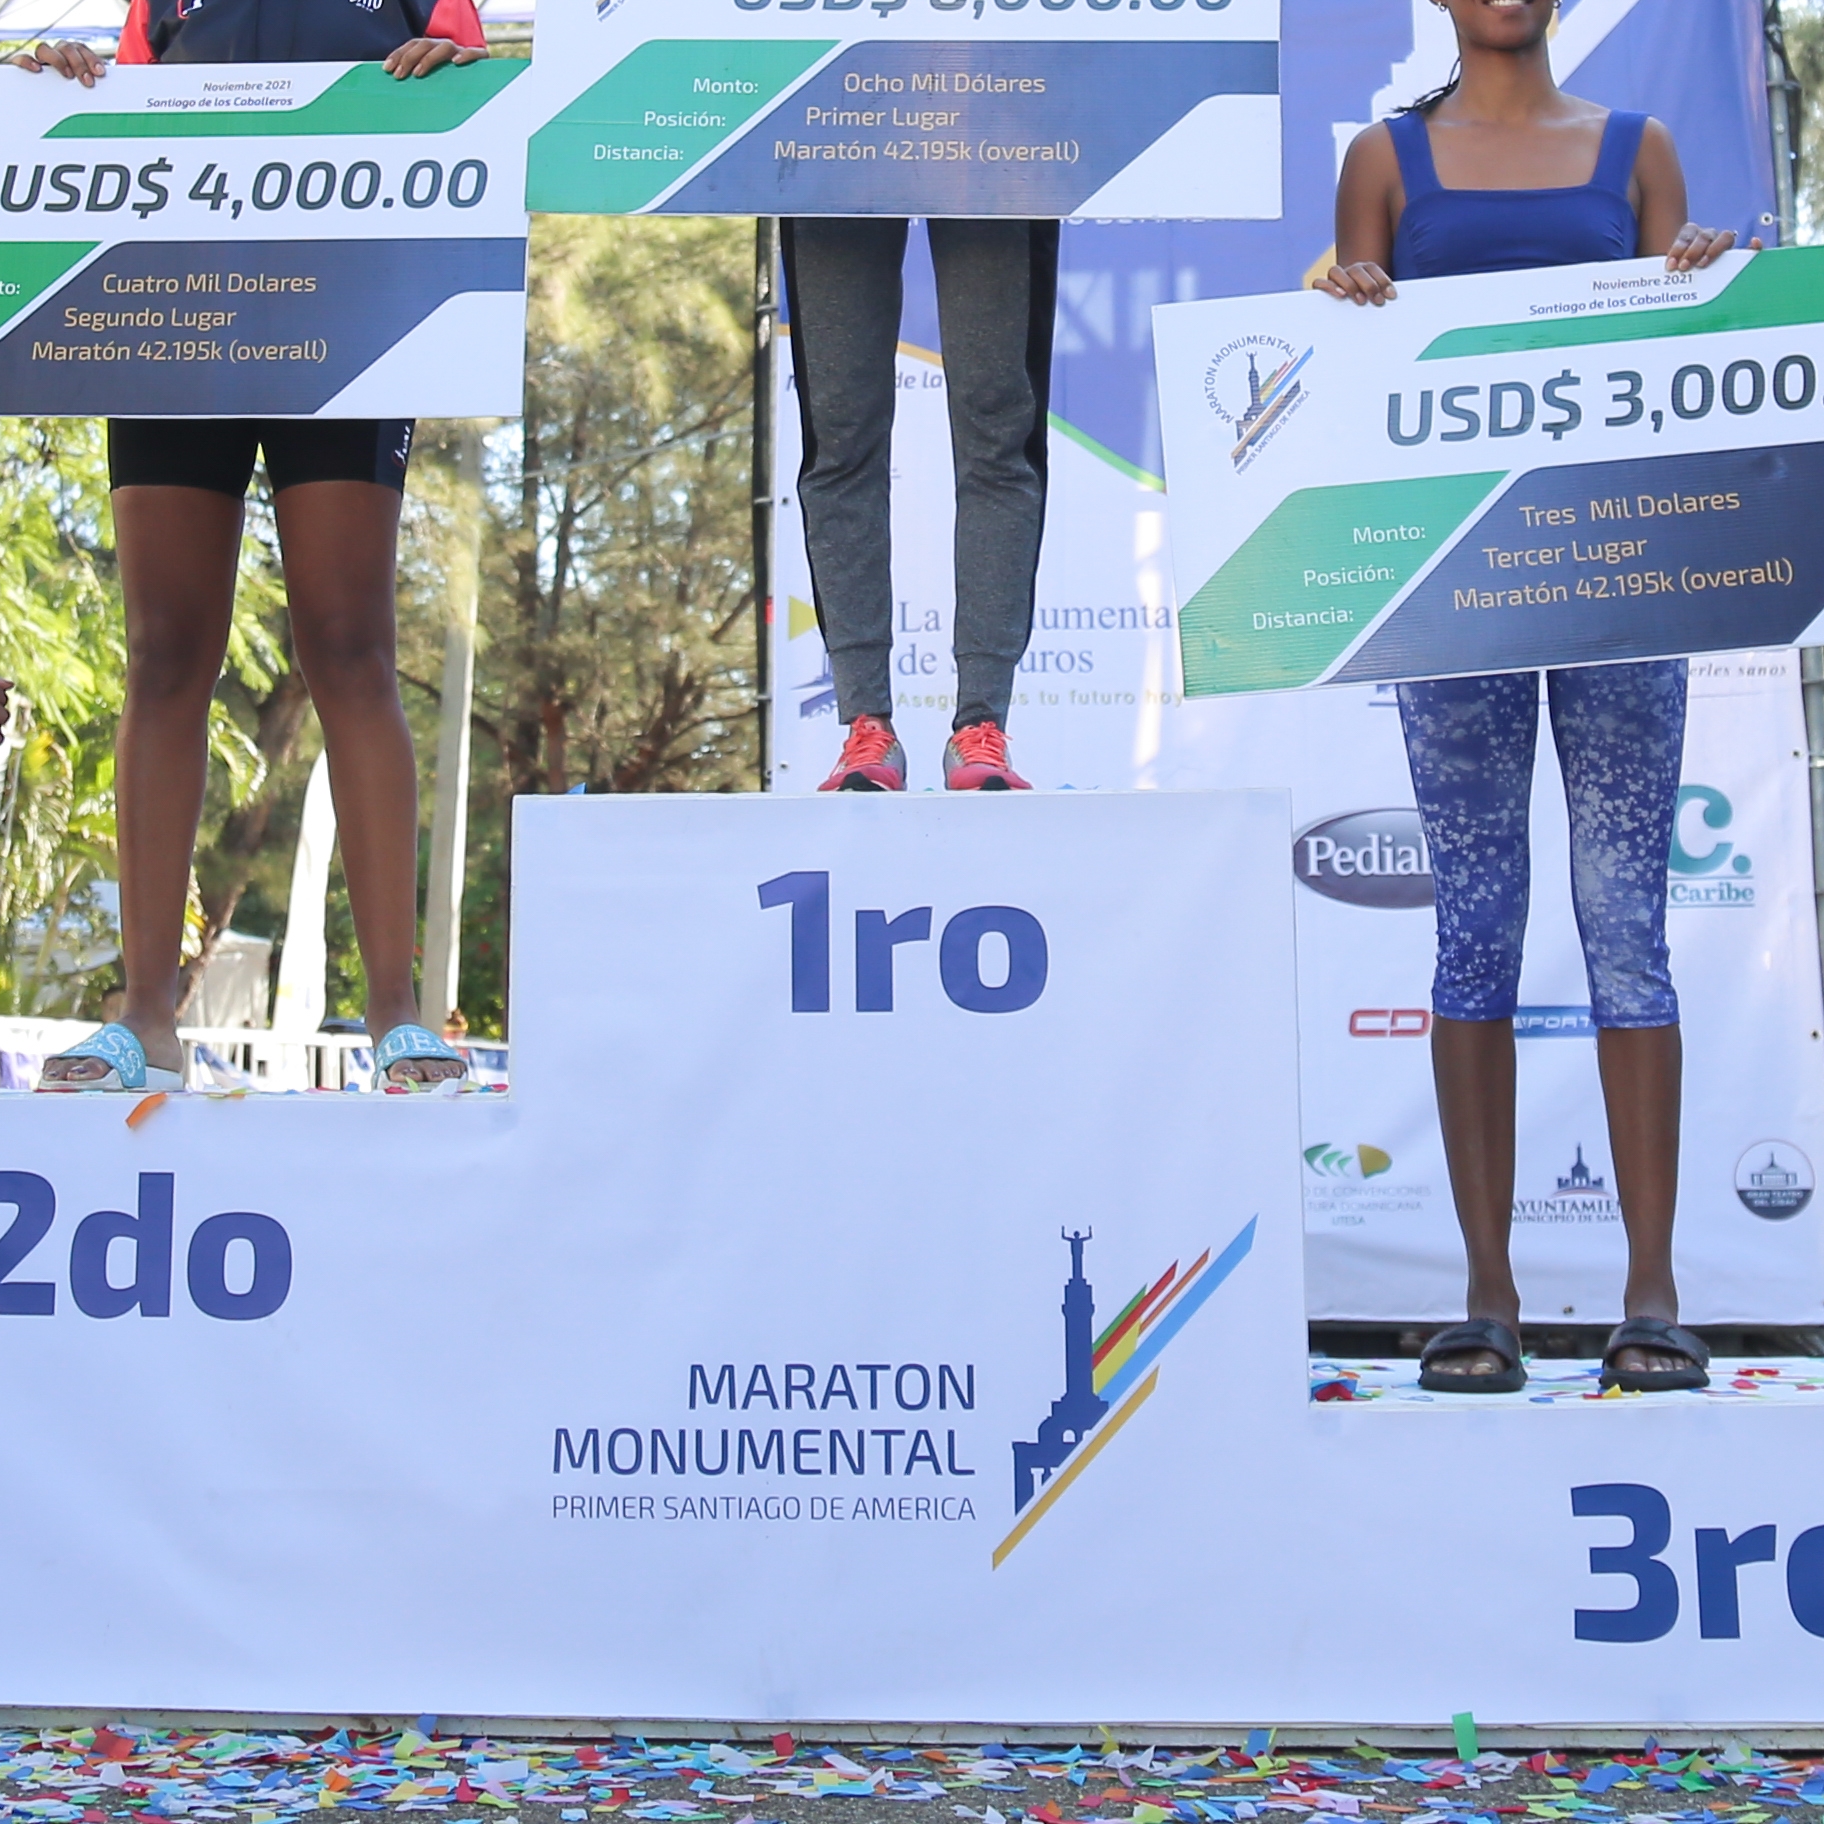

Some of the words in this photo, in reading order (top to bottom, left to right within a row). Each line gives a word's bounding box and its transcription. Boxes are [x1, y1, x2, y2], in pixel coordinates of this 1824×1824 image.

[203, 80, 263, 93] Noviembre
[265, 81, 291, 90] 2021
[694, 78, 758, 95] Monto:
[845, 73, 903, 92] Ocho
[912, 73, 948, 92] Mil
[954, 73, 1045, 92] Dólares
[147, 98, 196, 109] Santiago
[199, 98, 212, 107] de
[215, 97, 231, 107] los
[645, 111, 725, 126] Posición:
[807, 107, 886, 126] Primer
[893, 108, 960, 130] Lugar
[594, 145, 683, 161] Distancia:
[775, 141, 876, 160] Maratón
[884, 141, 971, 160] 42.195k
[979, 140, 1078, 163] (overall)
[0, 157, 173, 219] USD$
[188, 159, 488, 220] 4,000.00
[104, 274, 178, 293] Cuatro
[186, 274, 221, 292] Mil
[228, 274, 316, 292] Dolares
[1593, 277, 1660, 291] Noviembre
[1663, 272, 1693, 286] 2021
[1530, 303, 1586, 315] Santiago
[1589, 299, 1604, 309] de
[1608, 298, 1626, 308] los
[64, 308, 163, 331] Segundo
[172, 308, 237, 331] Lugar
[32, 341, 130, 360] Maratón
[137, 341, 222, 360] 42.195k
[230, 339, 326, 363] (overall)
[1387, 369, 1581, 446] USD$
[1519, 506, 1576, 527] Tres
[1590, 498, 1632, 521] Mil
[1637, 493, 1740, 517] Dolares
[1354, 525, 1425, 544] Monto:
[1482, 548, 1565, 568] Tercer
[1572, 540, 1647, 564] Lugar
[1304, 564, 1394, 587] Posición:
[1454, 581, 1567, 610] Maratón
[1576, 571, 1674, 599] 42.195k
[1681, 558, 1792, 594] (overall)
[899, 602, 941, 633] La
[1253, 607, 1353, 629] Distancia:
[898, 643, 937, 675] de
[1039, 690, 1058, 705] tu
[1069, 689, 1135, 705] futuro
[1144, 690, 1184, 714] hoy
[1670, 883, 1754, 902] Caribe
[757, 871, 1048, 1013] 1ro
[689, 1364, 974, 1410] MARATON
[554, 1428, 975, 1475] MONUMENTAL
[554, 1496, 654, 1519] PRIMER
[664, 1497, 800, 1519] SANTIAGO
[811, 1497, 844, 1520] DE
[852, 1497, 975, 1520] AMERICA
